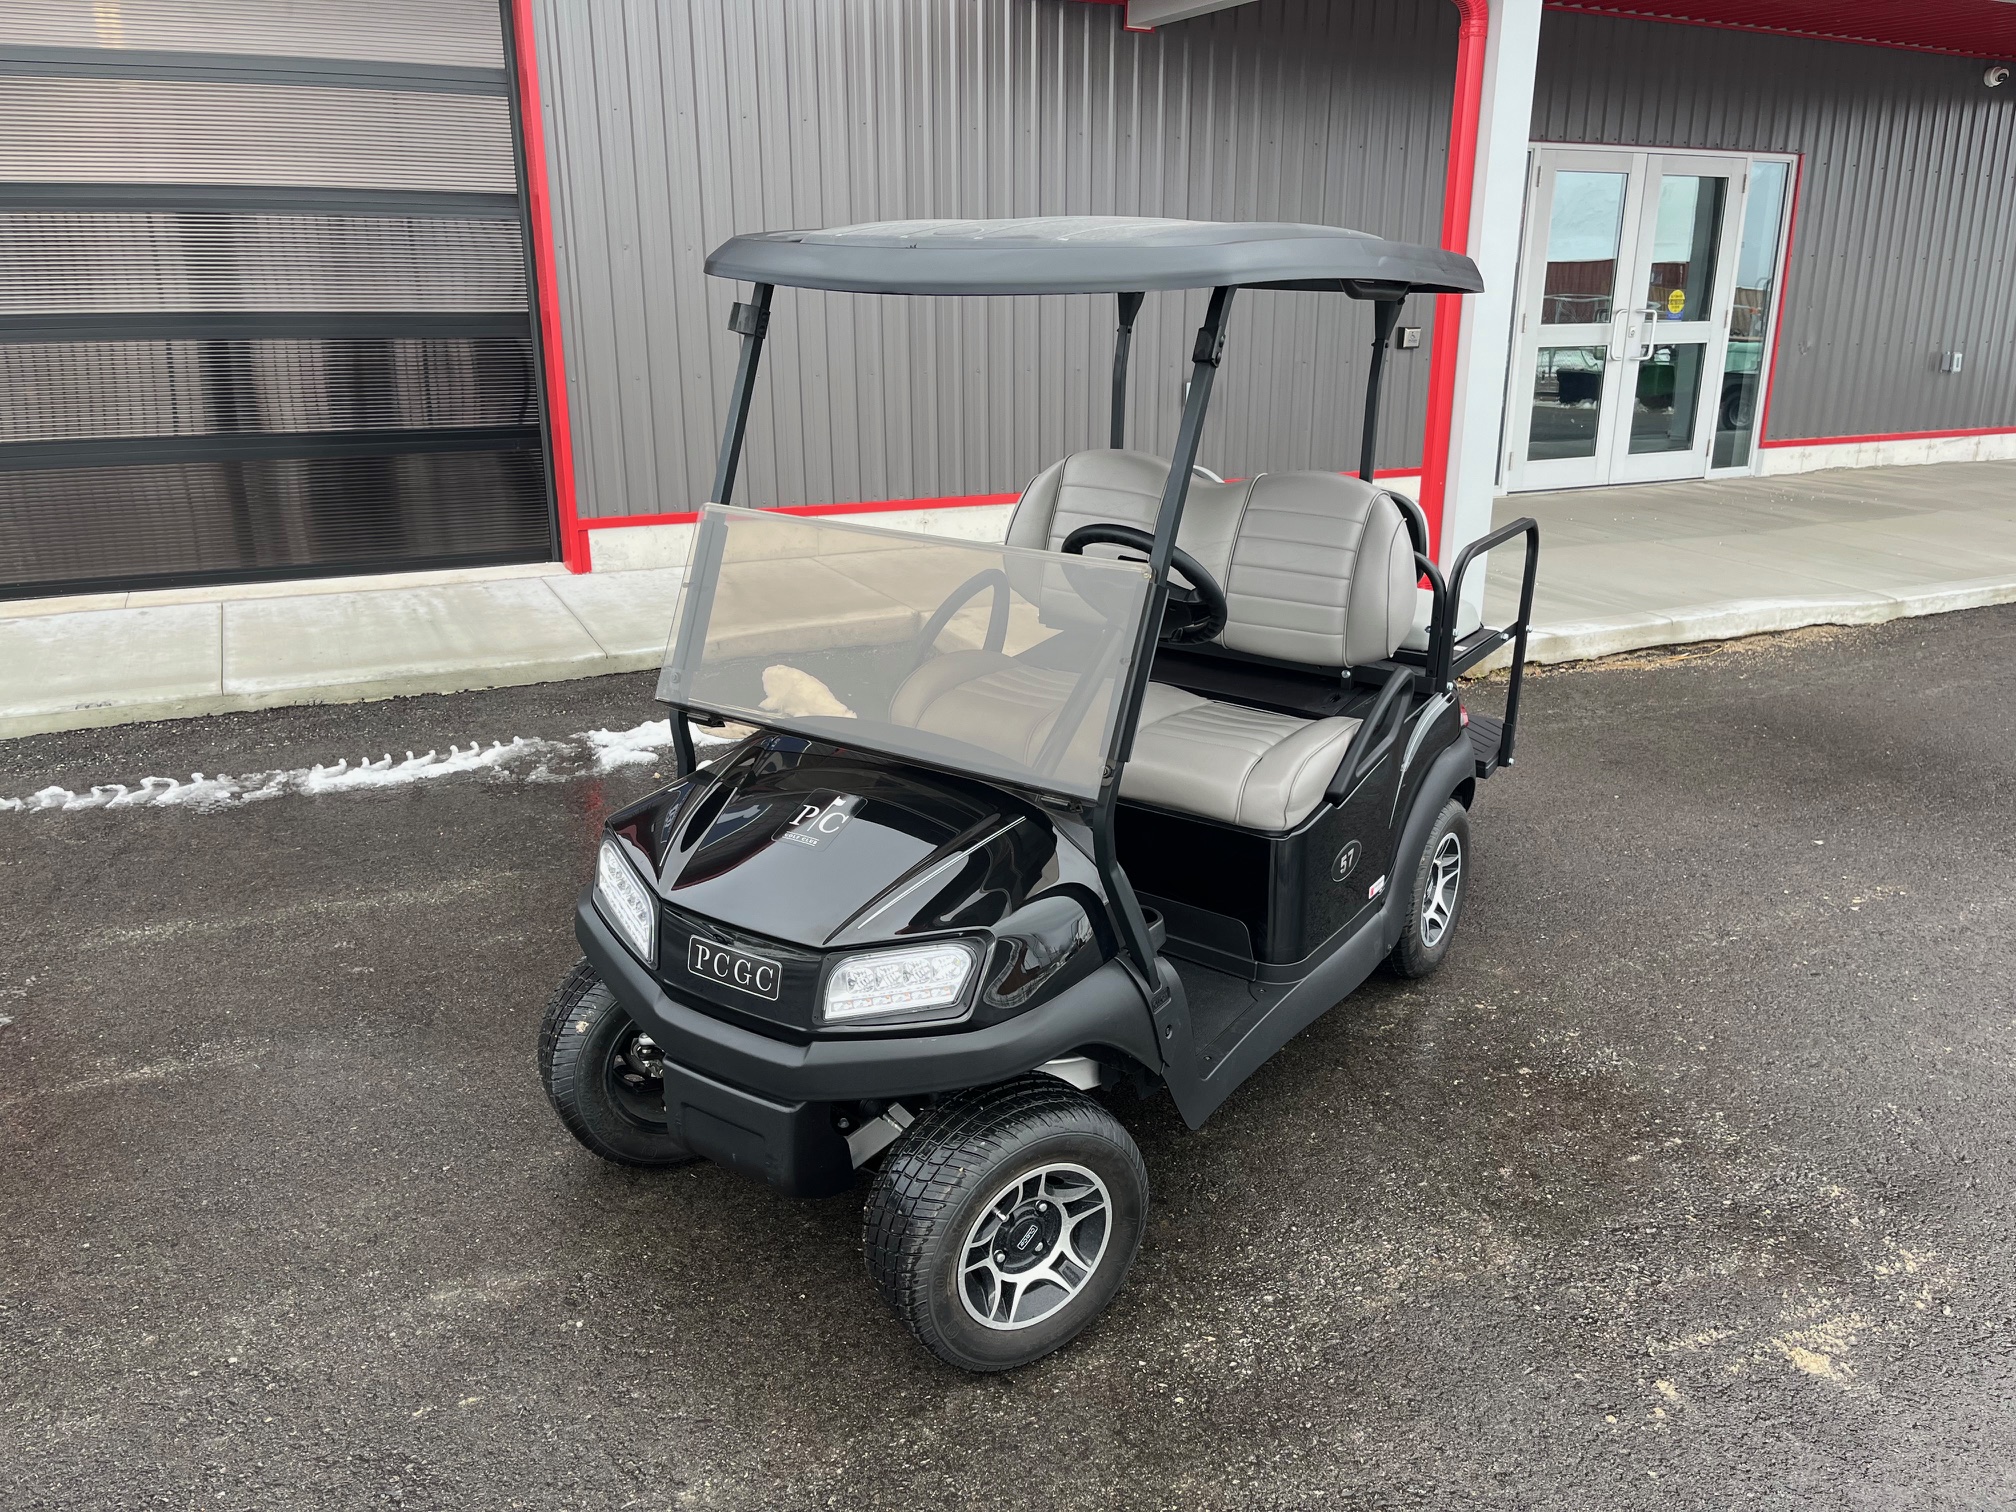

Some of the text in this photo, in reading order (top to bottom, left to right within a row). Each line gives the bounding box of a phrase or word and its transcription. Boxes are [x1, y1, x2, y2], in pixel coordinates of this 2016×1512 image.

[801, 837, 818, 845] CLUB
[1340, 847, 1355, 874] 57
[694, 944, 774, 992] PCGC
